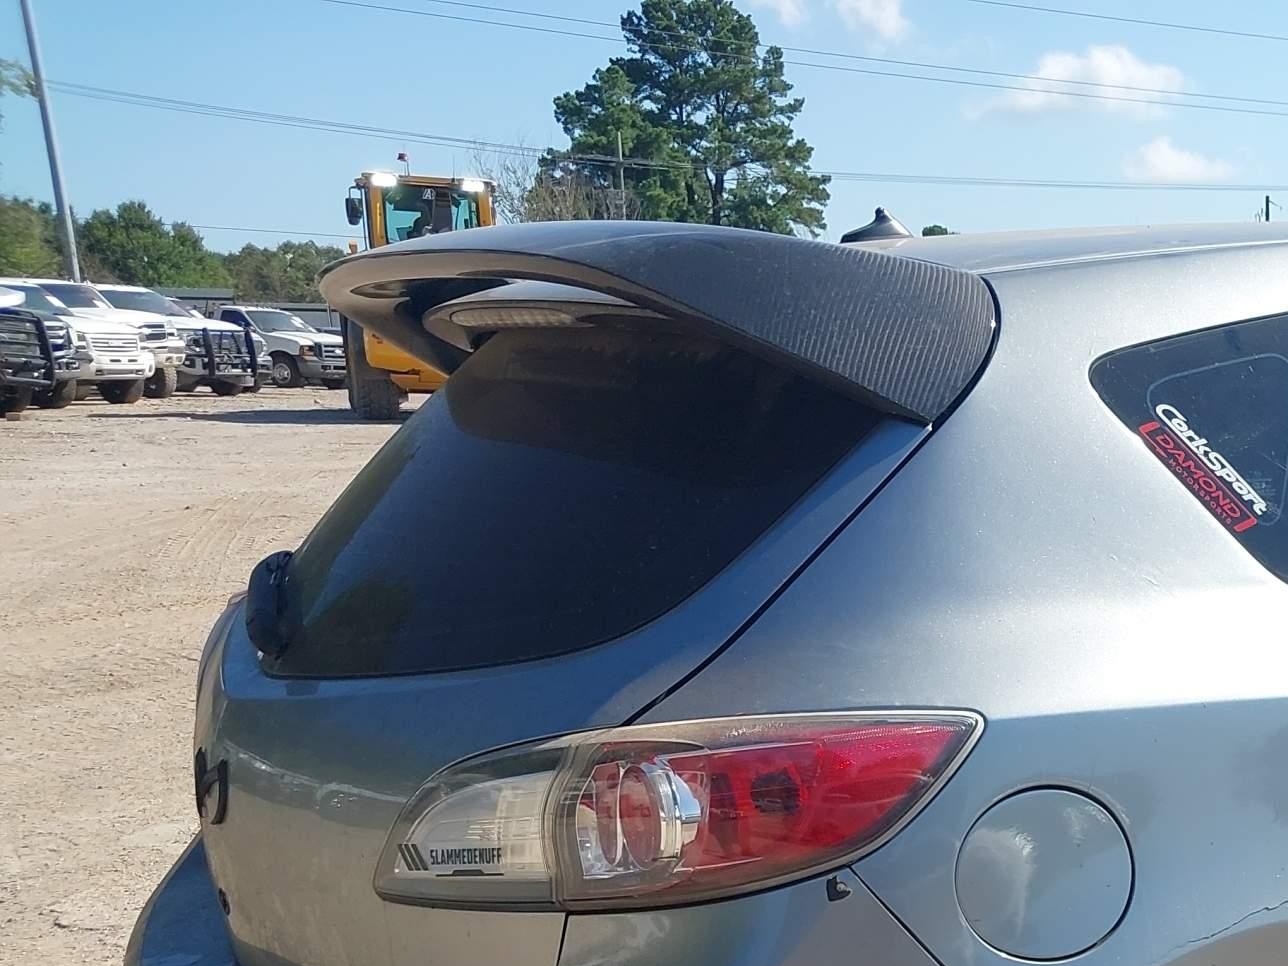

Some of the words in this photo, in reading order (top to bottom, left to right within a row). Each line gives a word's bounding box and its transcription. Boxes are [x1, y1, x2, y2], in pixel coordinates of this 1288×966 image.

[1155, 404, 1267, 515] CorkSport
[1155, 434, 1241, 518] DAMOND
[1168, 459, 1232, 525] MOTORSPORTS
[429, 847, 503, 866] SLAMMEDENUFF
